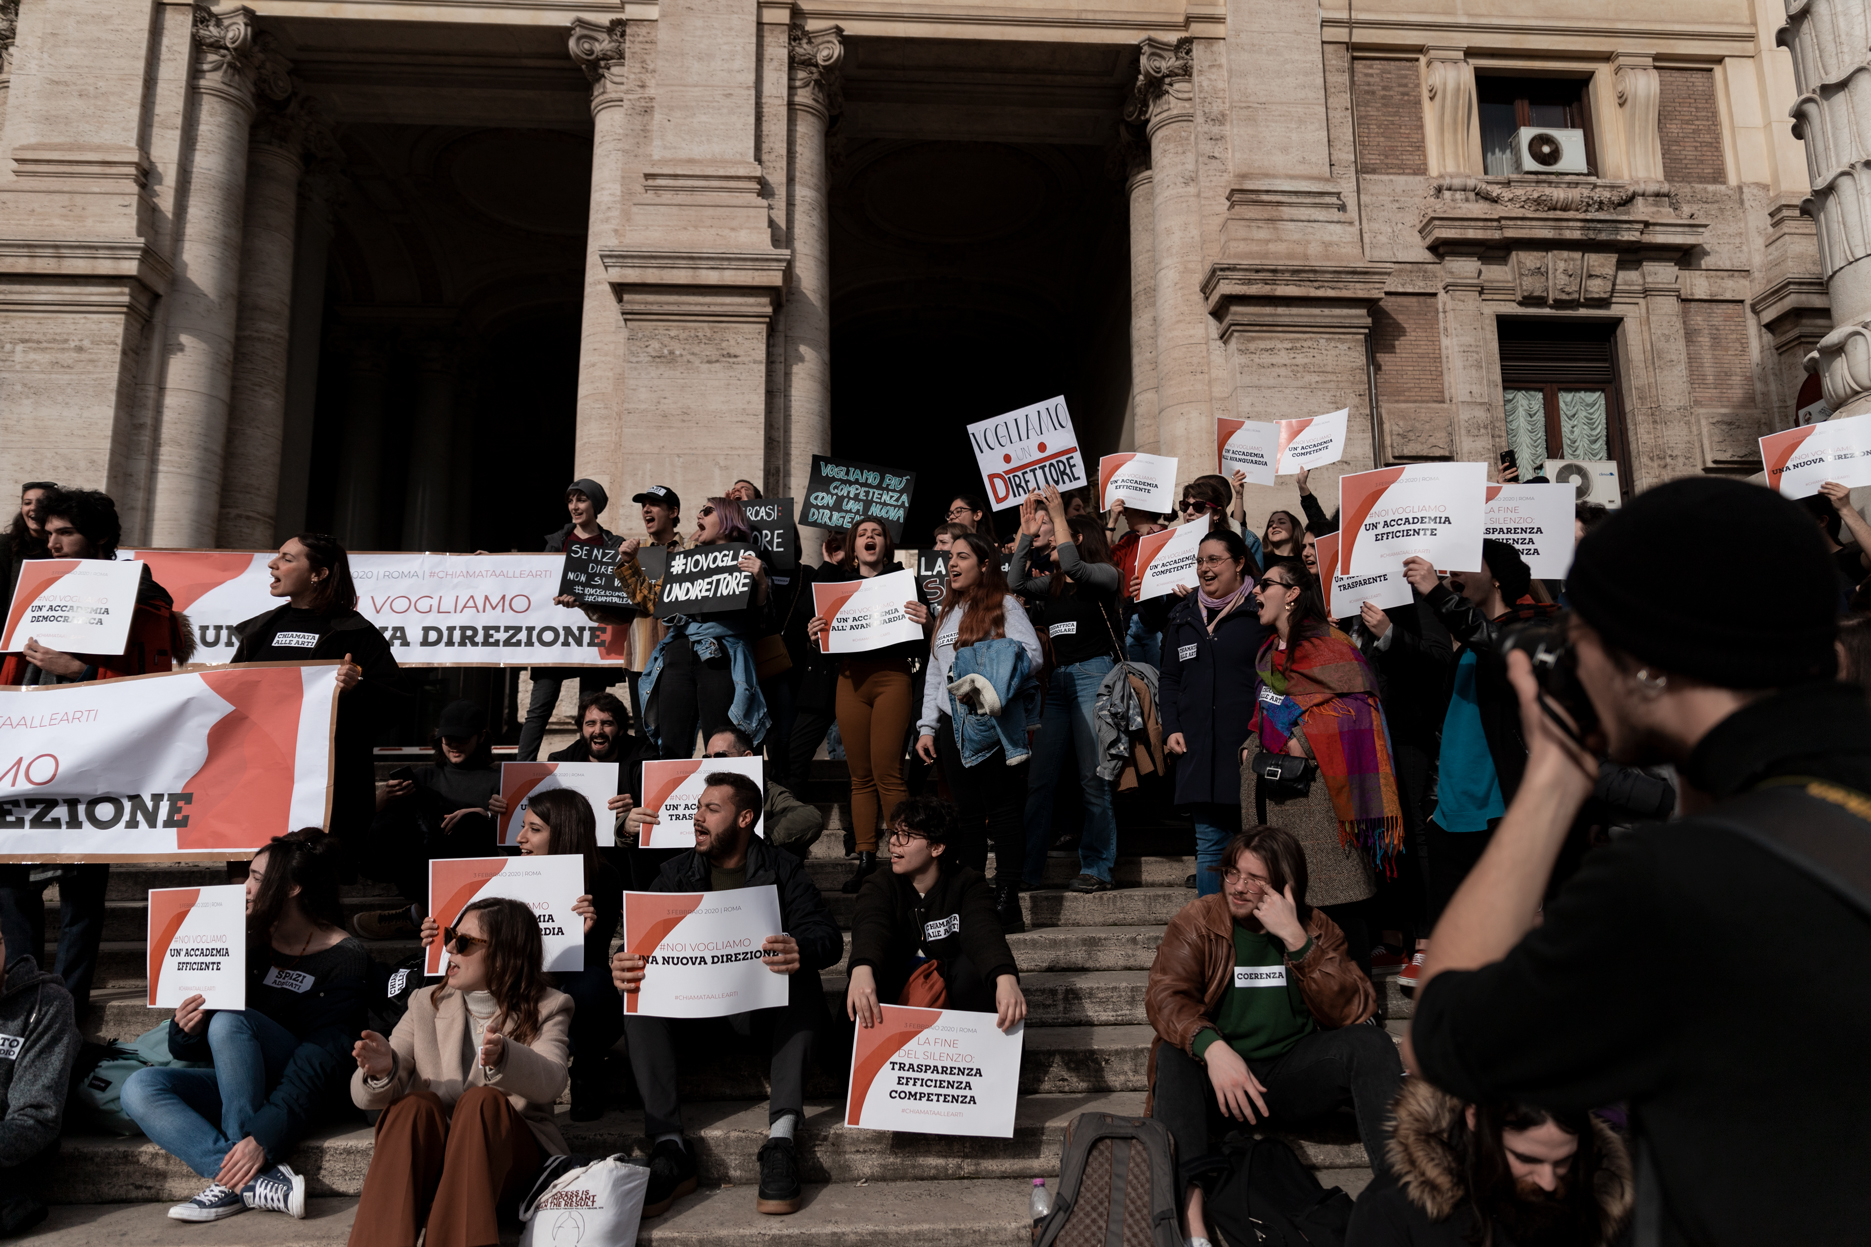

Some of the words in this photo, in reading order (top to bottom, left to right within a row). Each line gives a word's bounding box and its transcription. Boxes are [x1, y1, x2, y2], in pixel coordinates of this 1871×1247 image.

[970, 403, 1068, 454] VOGLIAMO
[1300, 438, 1333, 451] ACCADEMIA
[1015, 445, 1032, 461] UN
[1231, 449, 1265, 459] ACCADEMIA
[1291, 445, 1330, 457] COMPETENTE
[1229, 456, 1268, 467] AVANGUARDIA
[1771, 464, 1792, 475] UNA
[1792, 457, 1826, 470] NUOVA
[820, 461, 881, 486] VOGLIAMO
[987, 456, 1081, 504] DIRETTORE
[1120, 478, 1159, 489] ACCADEMIA
[829, 481, 909, 507] COMPETENZA
[1114, 485, 1151, 494] EFFICIENTE
[810, 491, 836, 508] CON
[842, 497, 864, 515] UNA
[868, 502, 905, 524] NUOVA
[1369, 508, 1389, 519] #NOI
[1391, 504, 1447, 516] VOGLIAMO
[1498, 506, 1519, 514] FINE
[1382, 516, 1452, 529] ACCADEMIA
[1489, 516, 1535, 525] SILENZIO:
[1374, 528, 1437, 542] EFFICIENTE
[1160, 553, 1196, 569] ACCADEMIA
[382, 570, 420, 580] ROMA
[428, 569, 553, 580] #CHIAMATAALLEARTI
[1151, 562, 1192, 578] COMPETENTE
[567, 571, 587, 583] NON
[591, 577, 605, 585] SI
[1338, 574, 1389, 592] TRASPARENTE
[663, 571, 752, 603] UNDIRETTORE
[37, 595, 58, 603] #NOI
[370, 593, 532, 615] VOGLIAMO
[47, 604, 110, 615] ACCADEMIA
[839, 608, 857, 616] #NOI
[277, 632, 317, 642] CHIAMATA
[419, 625, 608, 648] DIREZIONE
[273, 639, 294, 647] ALLE
[294, 639, 315, 648] ARTI
[669, 794, 690, 802] #NOI
[665, 803, 682, 811] UN'
[672, 908, 704, 916] FEBBRAIO
[704, 907, 719, 915] 2020
[723, 905, 742, 913] ROMA
[174, 935, 191, 944] #NOI
[191, 934, 227, 944] VOGLIAMO
[927, 930, 942, 940] ALLE
[659, 943, 687, 953] #NOI
[690, 938, 752, 952] VOGLIAMO
[185, 948, 230, 958] ACCADEMIA
[177, 961, 221, 971] EFFICIENTE
[661, 955, 708, 966] NUOVA
[1236, 972, 1285, 980] COERENZA
[674, 991, 739, 1001] #CHIAMATAALLEARTI
[909, 1023, 939, 1032] FEBBRAIO
[959, 1026, 978, 1034] ROMA
[917, 1037, 932, 1047] LA
[933, 1038, 959, 1049] FINE
[897, 1048, 921, 1060] DEL
[922, 1050, 976, 1064] SILENZIO:
[889, 1061, 983, 1078] TRASPARENZA
[896, 1076, 973, 1091] EFFICIENZA
[889, 1090, 977, 1105] COMPETENZA
[901, 1108, 964, 1118] #CHIAMATAALLEARTI
[563, 1200, 597, 1208] RESULT
